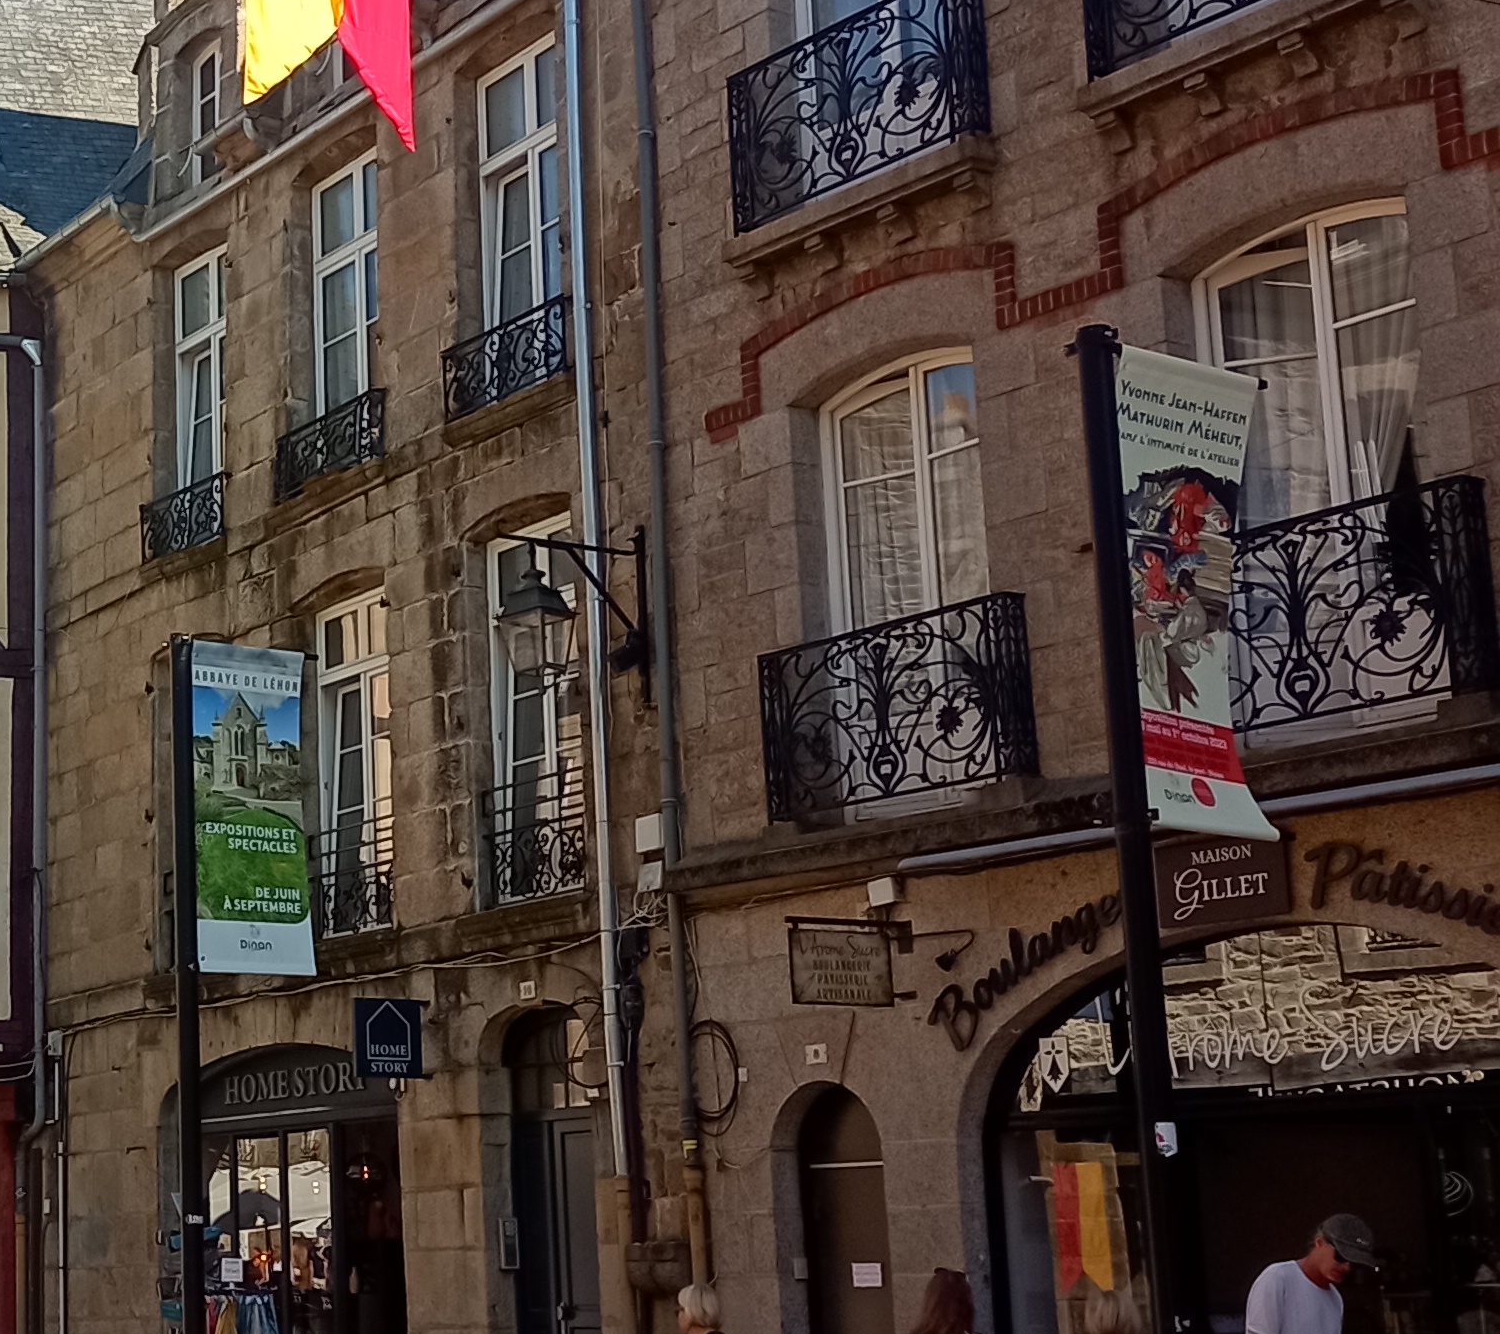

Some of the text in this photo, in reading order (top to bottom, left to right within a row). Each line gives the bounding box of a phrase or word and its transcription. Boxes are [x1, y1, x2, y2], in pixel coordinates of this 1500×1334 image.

[1121, 379, 1166, 406] YVONNE
[1118, 402, 1184, 434] MATHURIN
[1120, 431, 1138, 443] ANS
[1187, 446, 1198, 458] DE
[194, 669, 238, 686] ABBAYE
[244, 675, 257, 688] DE
[205, 821, 297, 841] EXPOSITIONS ET
[227, 837, 298, 855] SPECTACLES
[1191, 844, 1252, 865] MAISON
[255, 886, 301, 902] DE JUIN
[1173, 868, 1269, 921] GILLET
[1303, 842, 1500, 935] Pâtissie
[223, 894, 302, 915] À SEPTEMBRE
[239, 939, 273, 952] Dinan
[927, 890, 1122, 1052] Boulange
[370, 1043, 408, 1056] HOME
[370, 1061, 409, 1074] STORY
[224, 1071, 289, 1105] HOME
